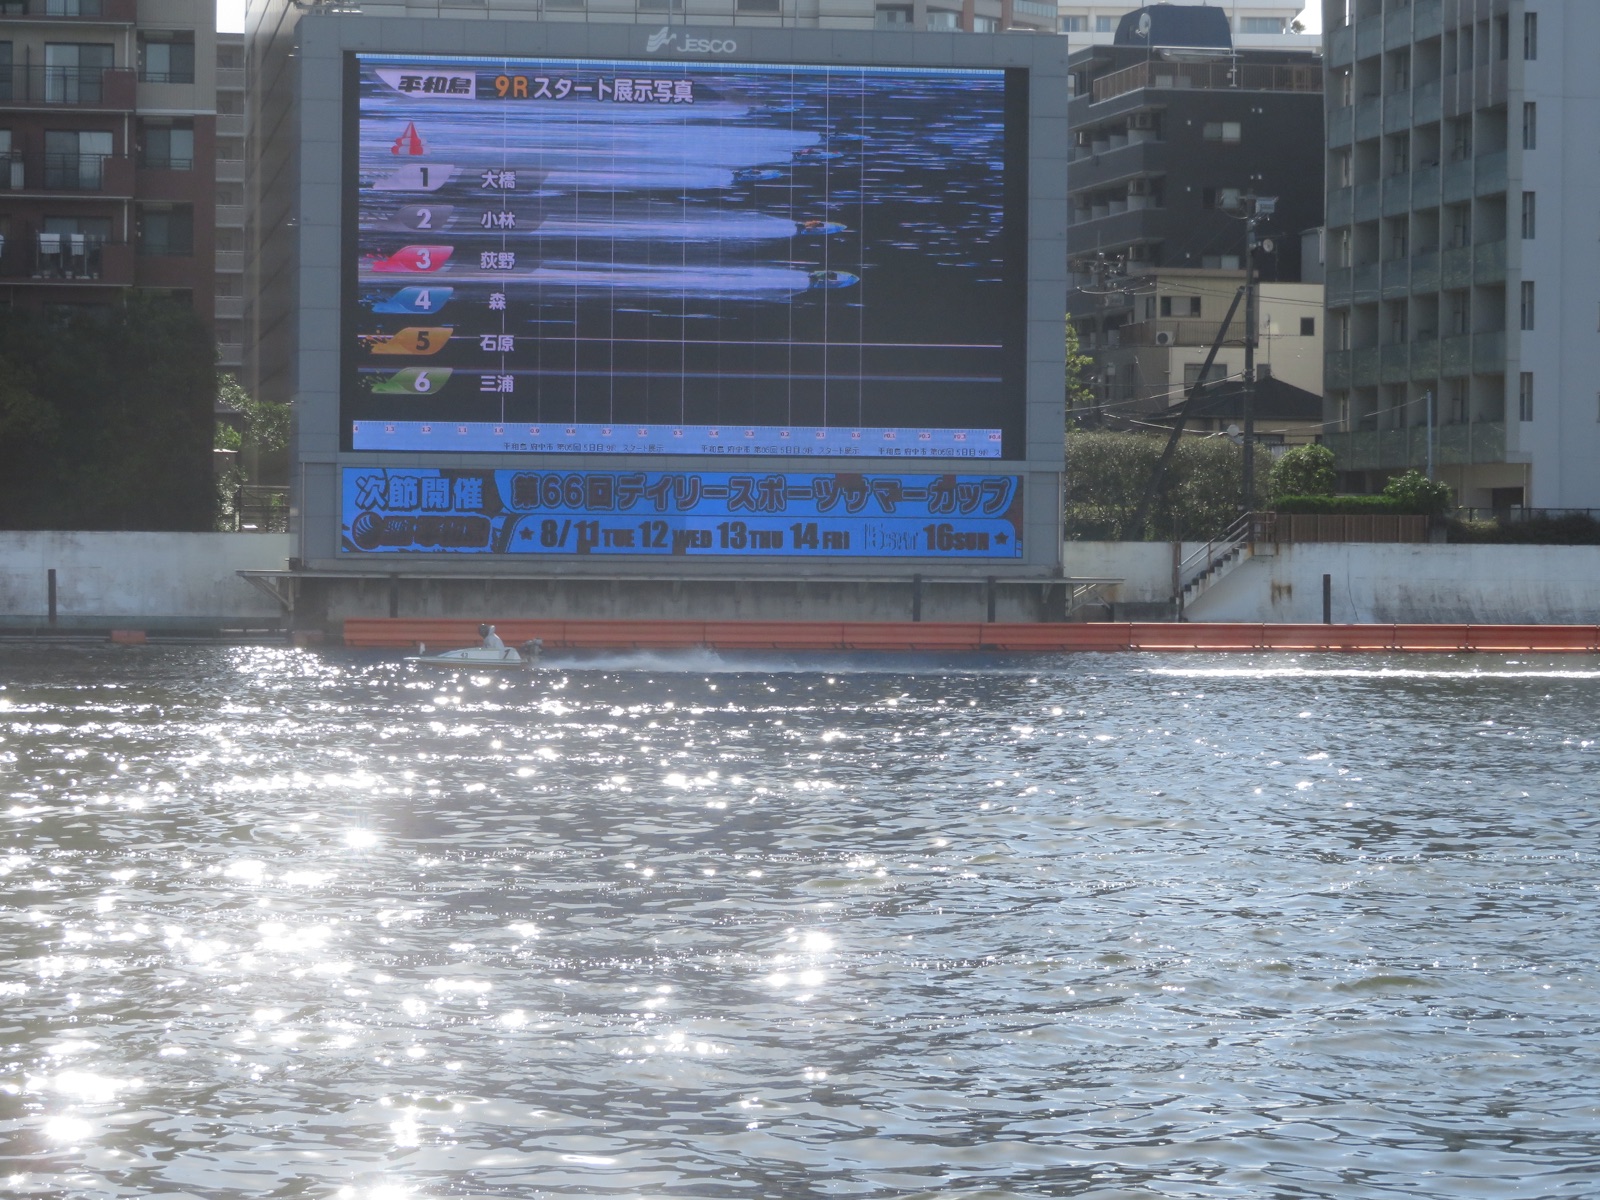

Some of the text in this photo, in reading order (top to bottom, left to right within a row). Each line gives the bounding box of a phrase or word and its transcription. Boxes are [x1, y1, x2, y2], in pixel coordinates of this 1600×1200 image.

[397, 75, 472, 94] 平和島
[495, 75, 694, 104] 9R スタート展示写真
[419, 167, 516, 189] 1 大橋
[416, 208, 516, 229] 2 小林
[416, 249, 516, 270] 3 荻野
[414, 290, 507, 311] 4 森
[416, 331, 515, 352] 5 石原
[414, 371, 515, 393] 6 三浦
[355, 475, 484, 512] 次節開催
[511, 473, 1012, 514] 第66回デイリースポーツサマーカップ
